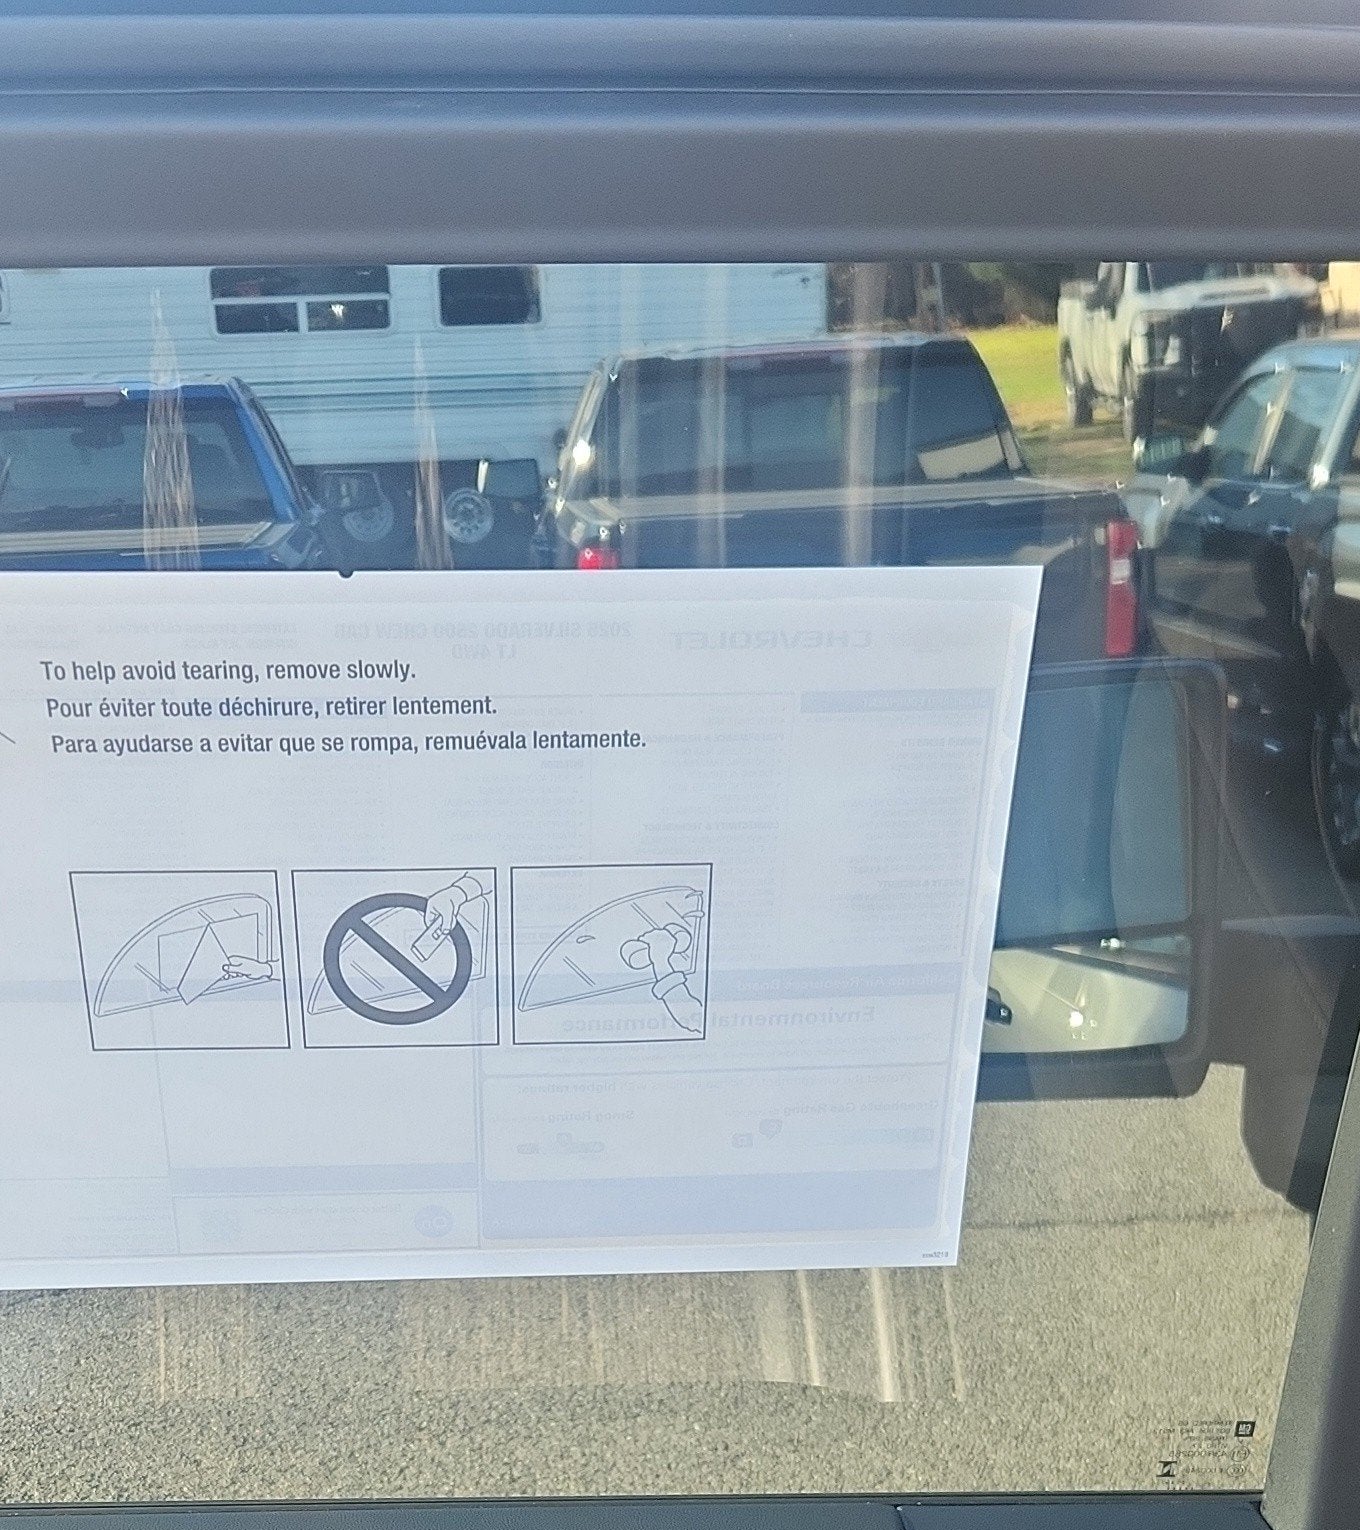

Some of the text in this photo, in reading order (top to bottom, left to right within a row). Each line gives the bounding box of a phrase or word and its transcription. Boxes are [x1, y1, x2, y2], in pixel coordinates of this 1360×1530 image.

[39, 659, 416, 685] To help avoid tearing, remove slowly.
[46, 698, 93, 718] Pour
[99, 697, 156, 717] éviter
[161, 698, 213, 717] toute
[218, 696, 319, 720] déchirure,
[325, 696, 387, 717] retirer
[392, 695, 497, 716] lentement.
[51, 729, 647, 757] Para ayudarse a evitar que se rompa, remuévala lentamente.
